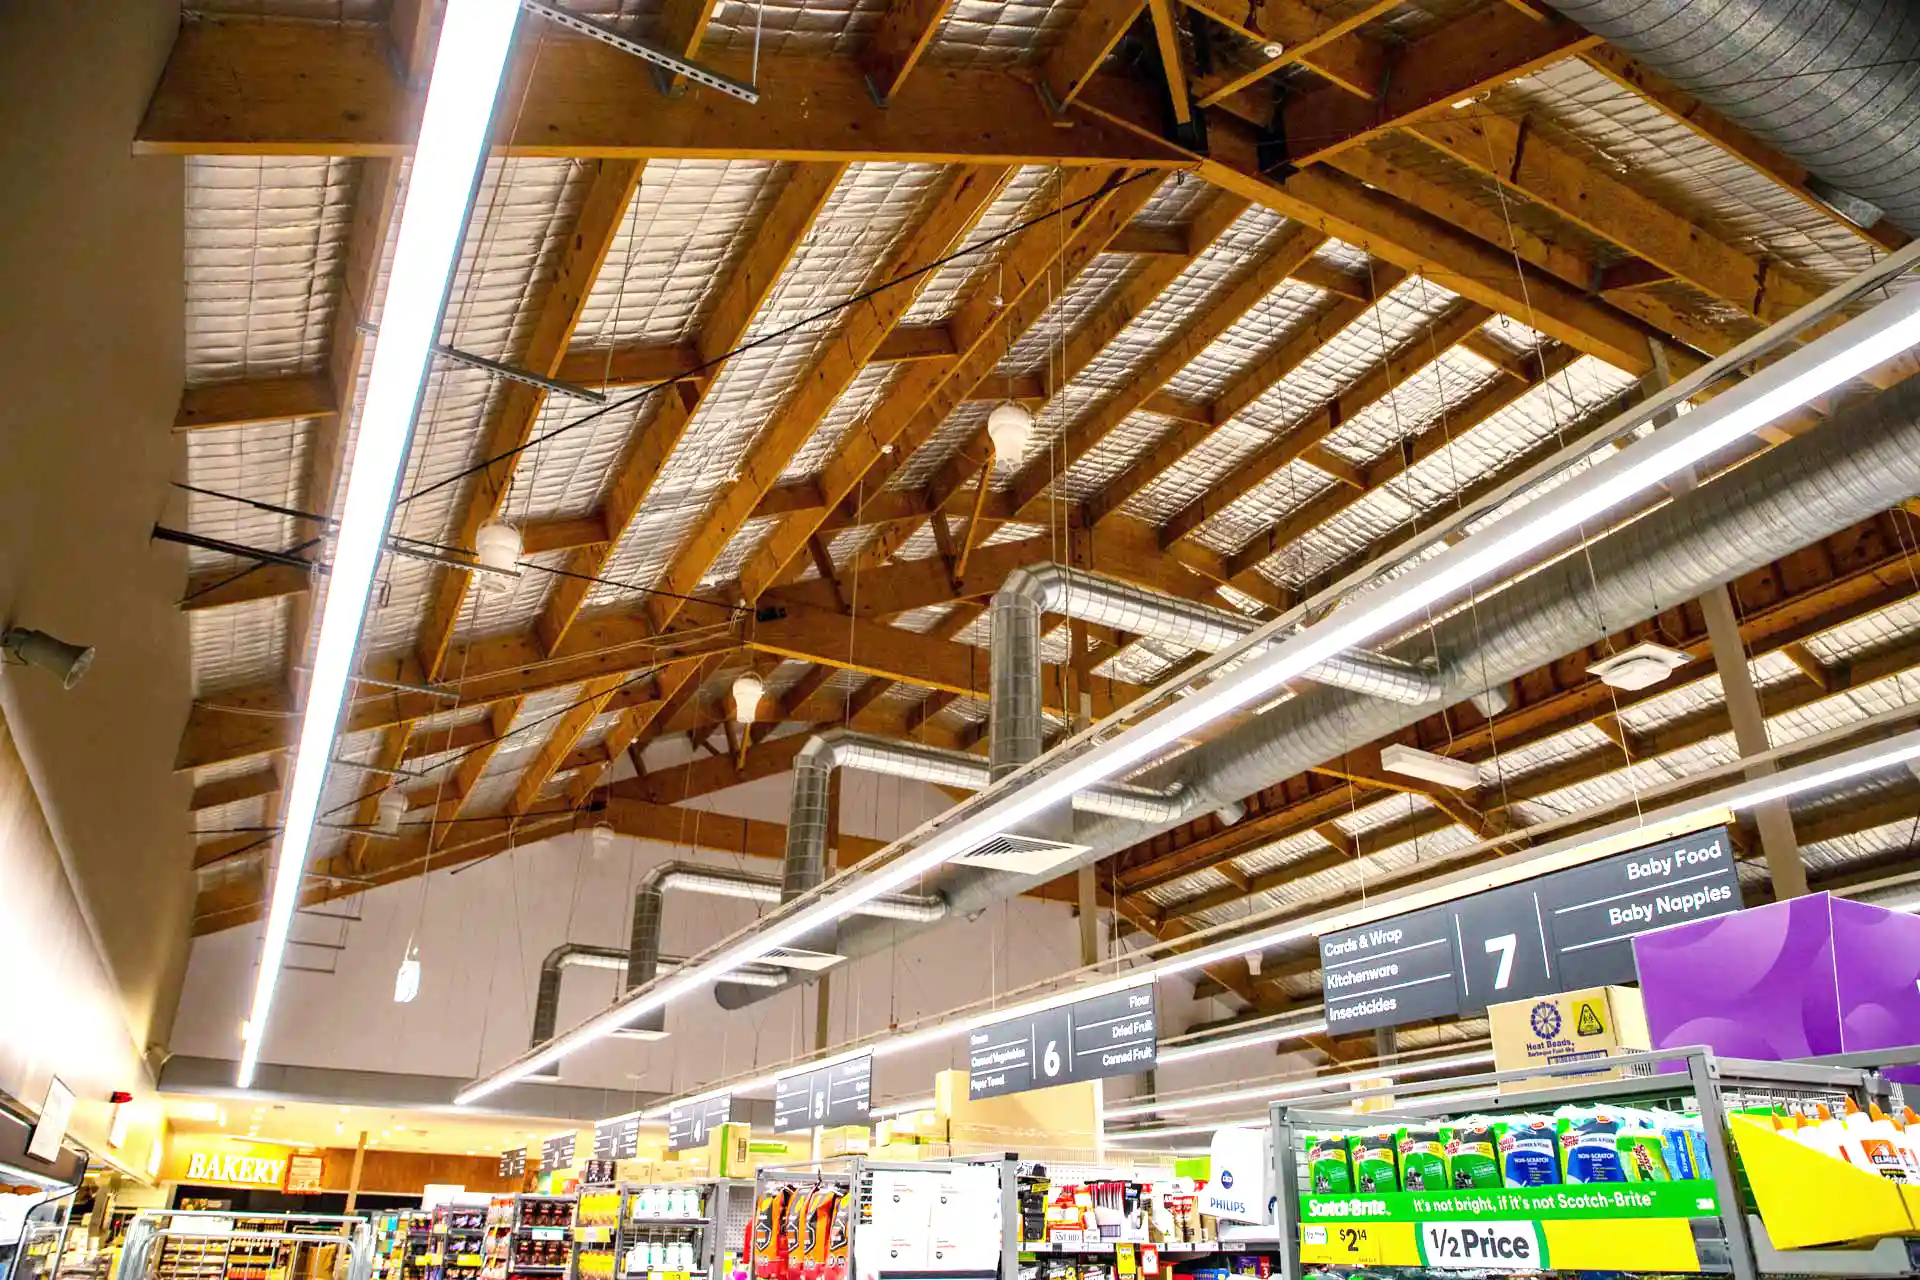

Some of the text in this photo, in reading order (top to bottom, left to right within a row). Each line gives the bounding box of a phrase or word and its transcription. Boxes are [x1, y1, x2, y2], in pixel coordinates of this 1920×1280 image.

[1626, 840, 1722, 880] Baby Food
[1608, 885, 1731, 925] Baby Nappies
[1324, 928, 1402, 957] Cards & Wrap
[1484, 933, 1517, 990] 7
[1327, 963, 1399, 989] Kitchenware
[1128, 995, 1151, 1008] Flour
[1329, 997, 1397, 1021] Insecticides
[1112, 1019, 1153, 1038] Dried Fruit
[1043, 1040, 1060, 1077] 6
[1102, 1046, 1153, 1066] Canned Fruit
[1527, 1041, 1544, 1051] Heat
[187, 1153, 286, 1184] BAKERY
[1210, 1197, 1246, 1214] PHILIPS
[1413, 1199, 1431, 1213] It's
[1432, 1198, 1452, 1212] not
[1455, 1195, 1497, 1214] bright,
[1498, 1196, 1508, 1210] if
[1509, 1195, 1530, 1210] it's
[1532, 1194, 1555, 1209] not
[1461, 1228, 1530, 1259] Price
